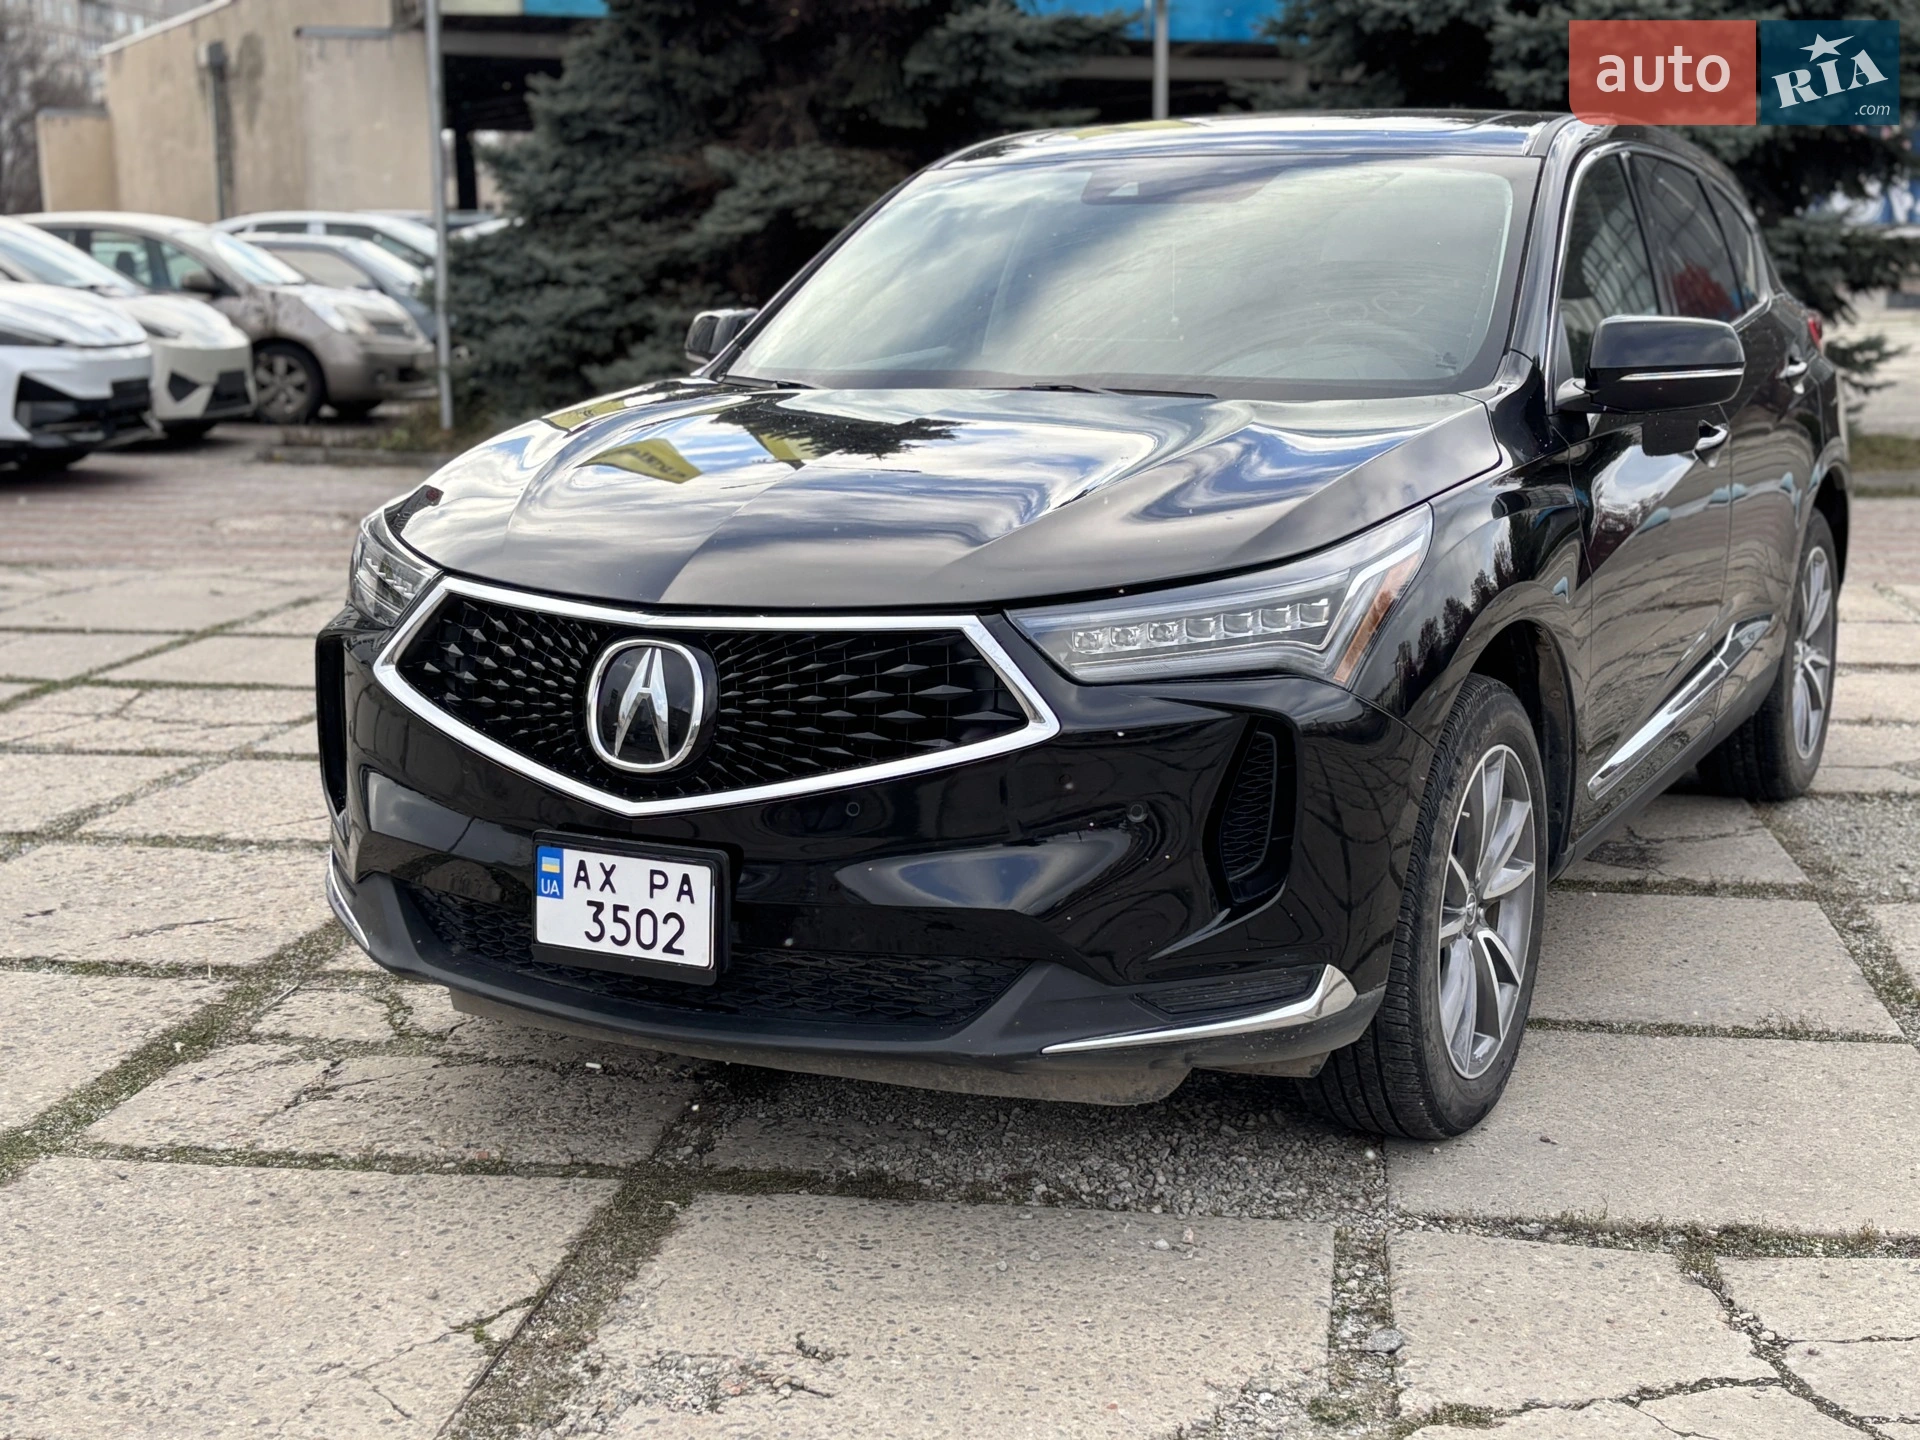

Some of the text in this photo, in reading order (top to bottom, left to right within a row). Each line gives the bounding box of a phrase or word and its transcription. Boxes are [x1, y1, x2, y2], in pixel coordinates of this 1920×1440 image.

[541, 878, 560, 896] UA
[573, 859, 695, 904] AX PA
[584, 899, 685, 956] 3502
